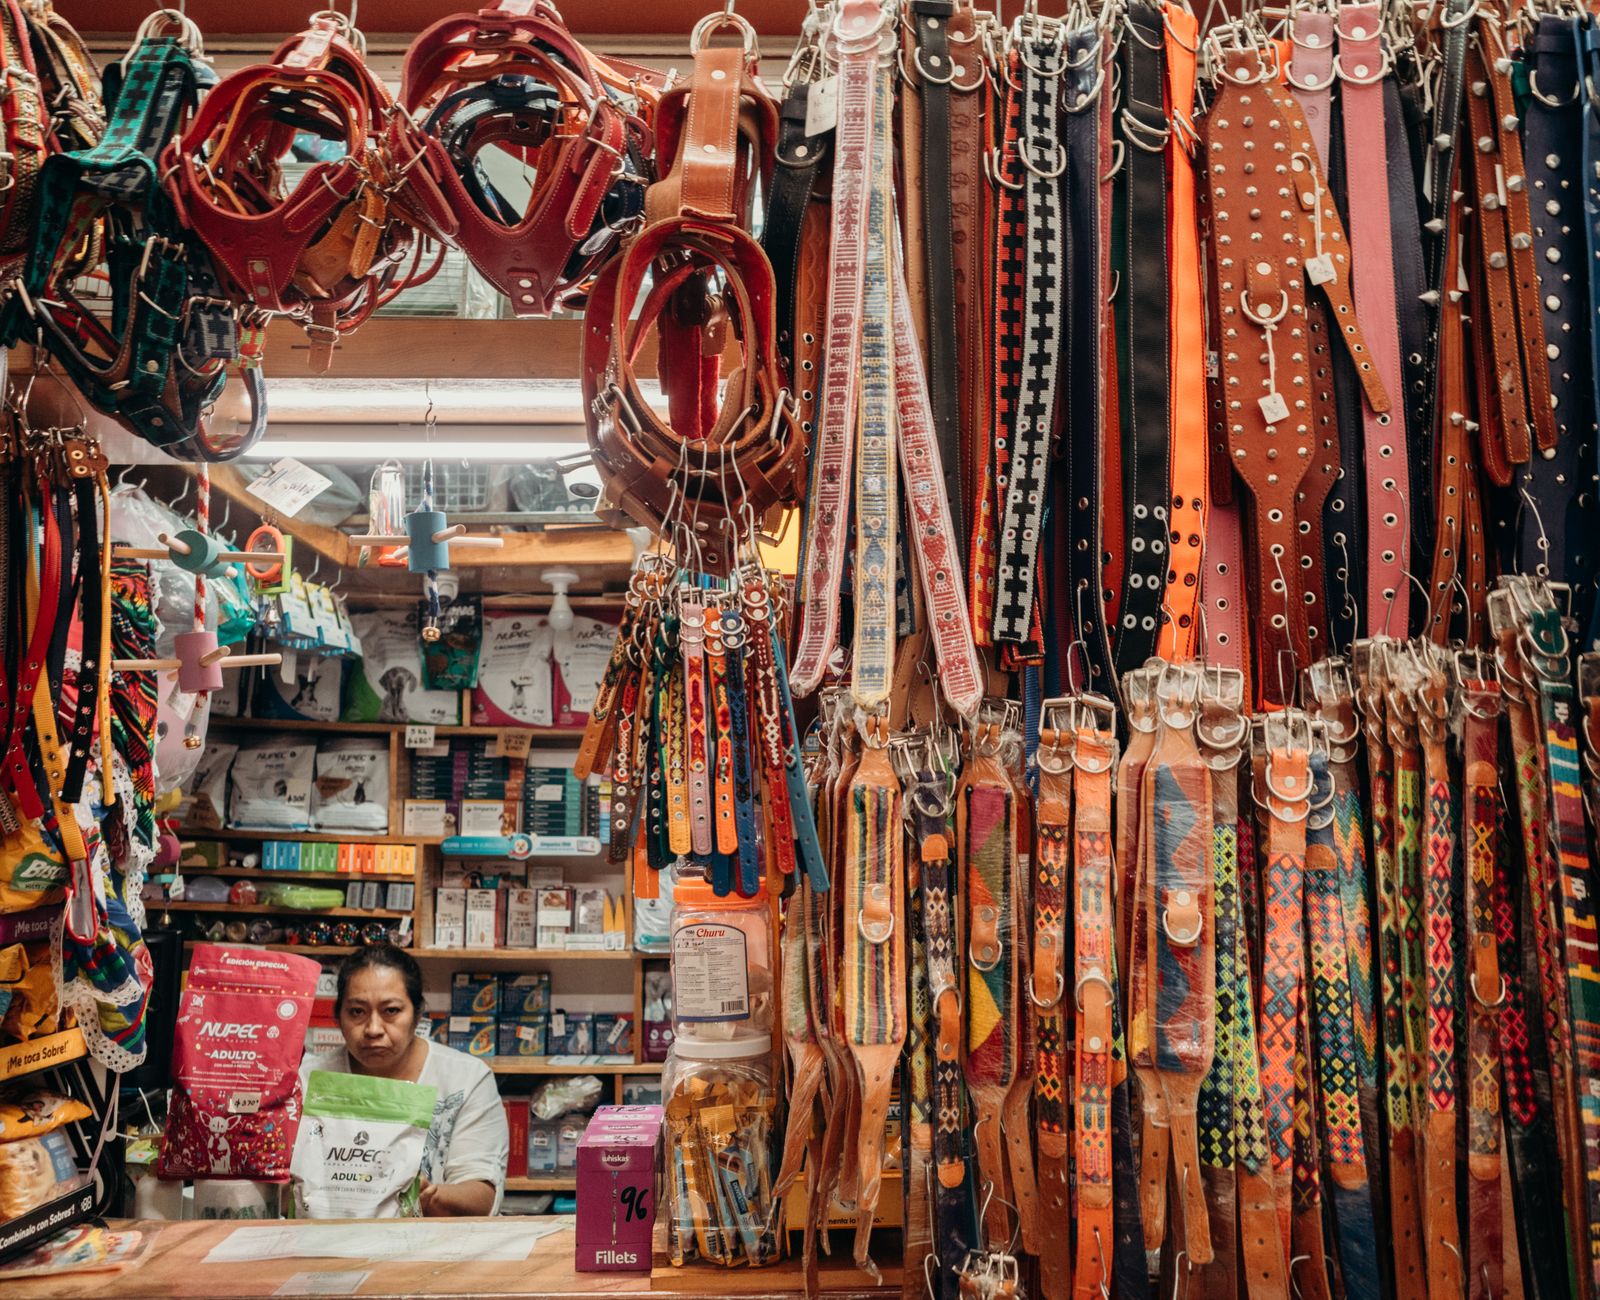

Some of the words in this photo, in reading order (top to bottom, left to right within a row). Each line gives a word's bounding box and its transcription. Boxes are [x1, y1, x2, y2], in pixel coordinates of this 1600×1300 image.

[826, 313, 853, 426] OAXACA
[863, 323, 887, 437] OAXACA
[696, 928, 725, 938] Churu
[199, 1021, 262, 1039] NUPEC
[24, 1052, 40, 1065] toca
[326, 1147, 385, 1164] NUPEC
[601, 1154, 630, 1163] whiskas
[620, 1186, 649, 1223] 96
[37, 1218, 49, 1233] con
[595, 1251, 638, 1265] Fillets
